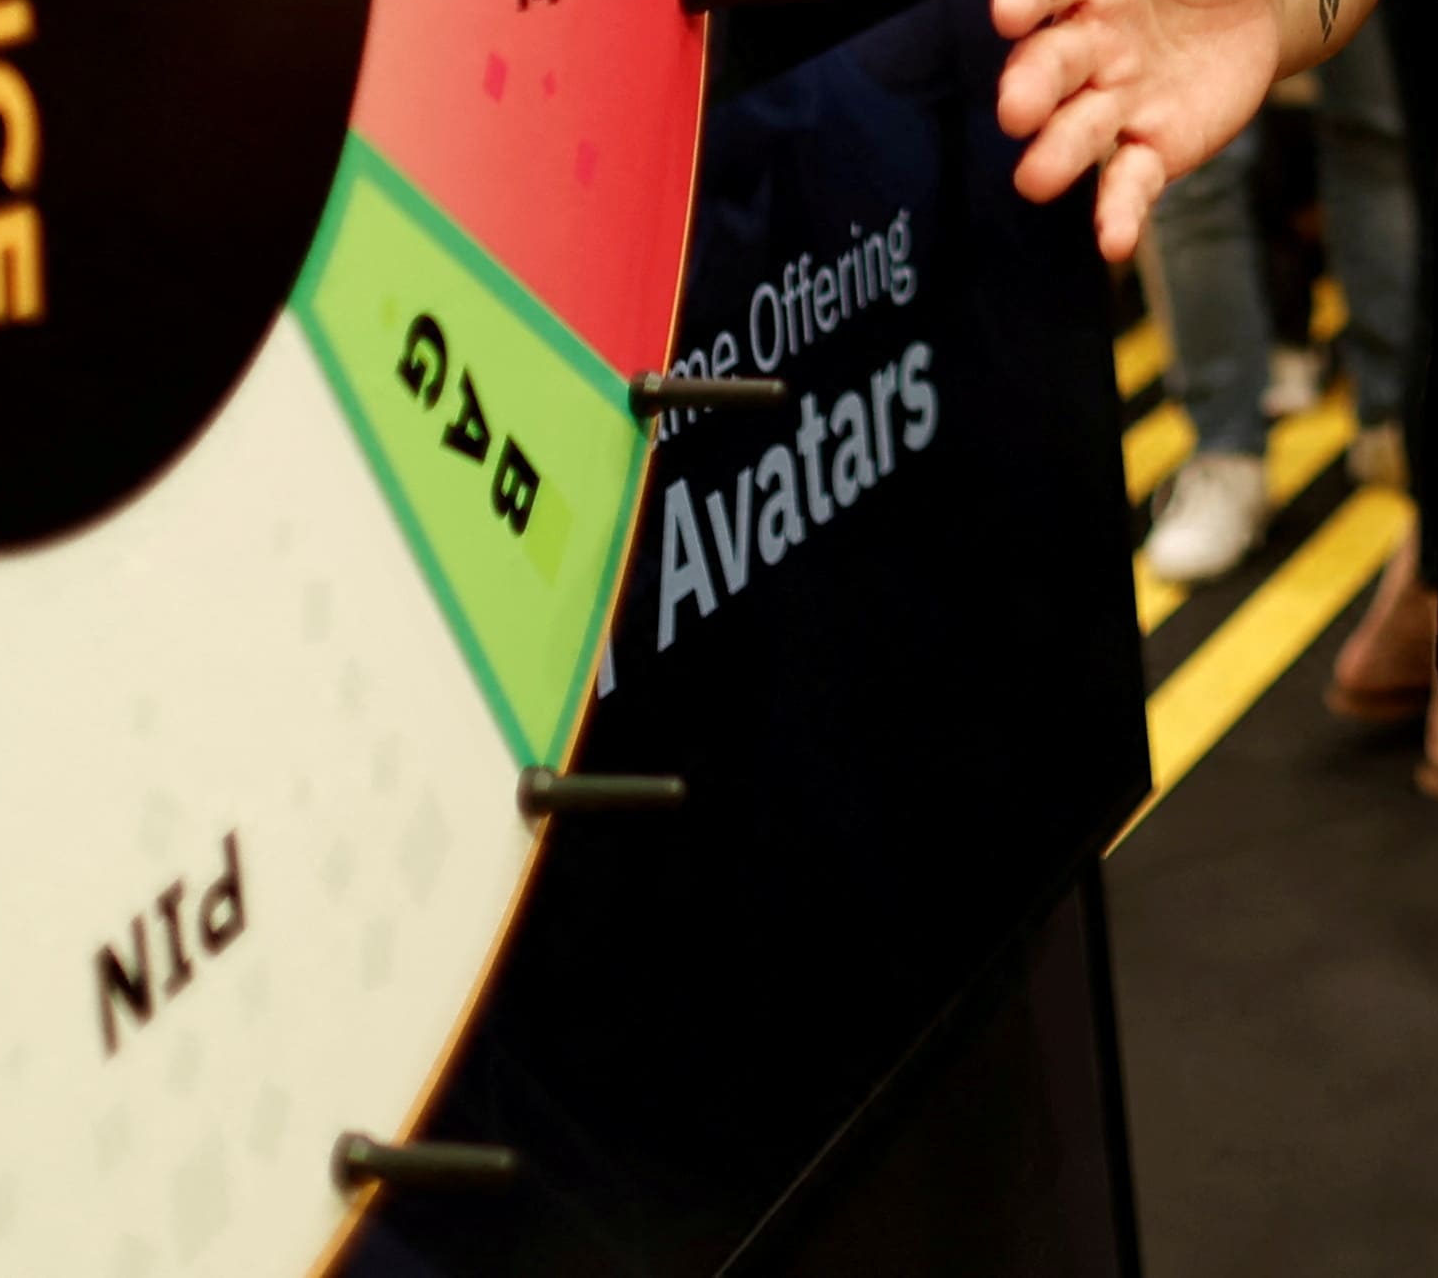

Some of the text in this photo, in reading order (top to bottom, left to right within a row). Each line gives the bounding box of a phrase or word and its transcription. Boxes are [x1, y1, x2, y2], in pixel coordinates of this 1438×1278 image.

[748, 206, 919, 374] Offering
[394, 311, 542, 537] BAG
[657, 341, 939, 652] Avatars
[93, 828, 250, 1061] PIN
